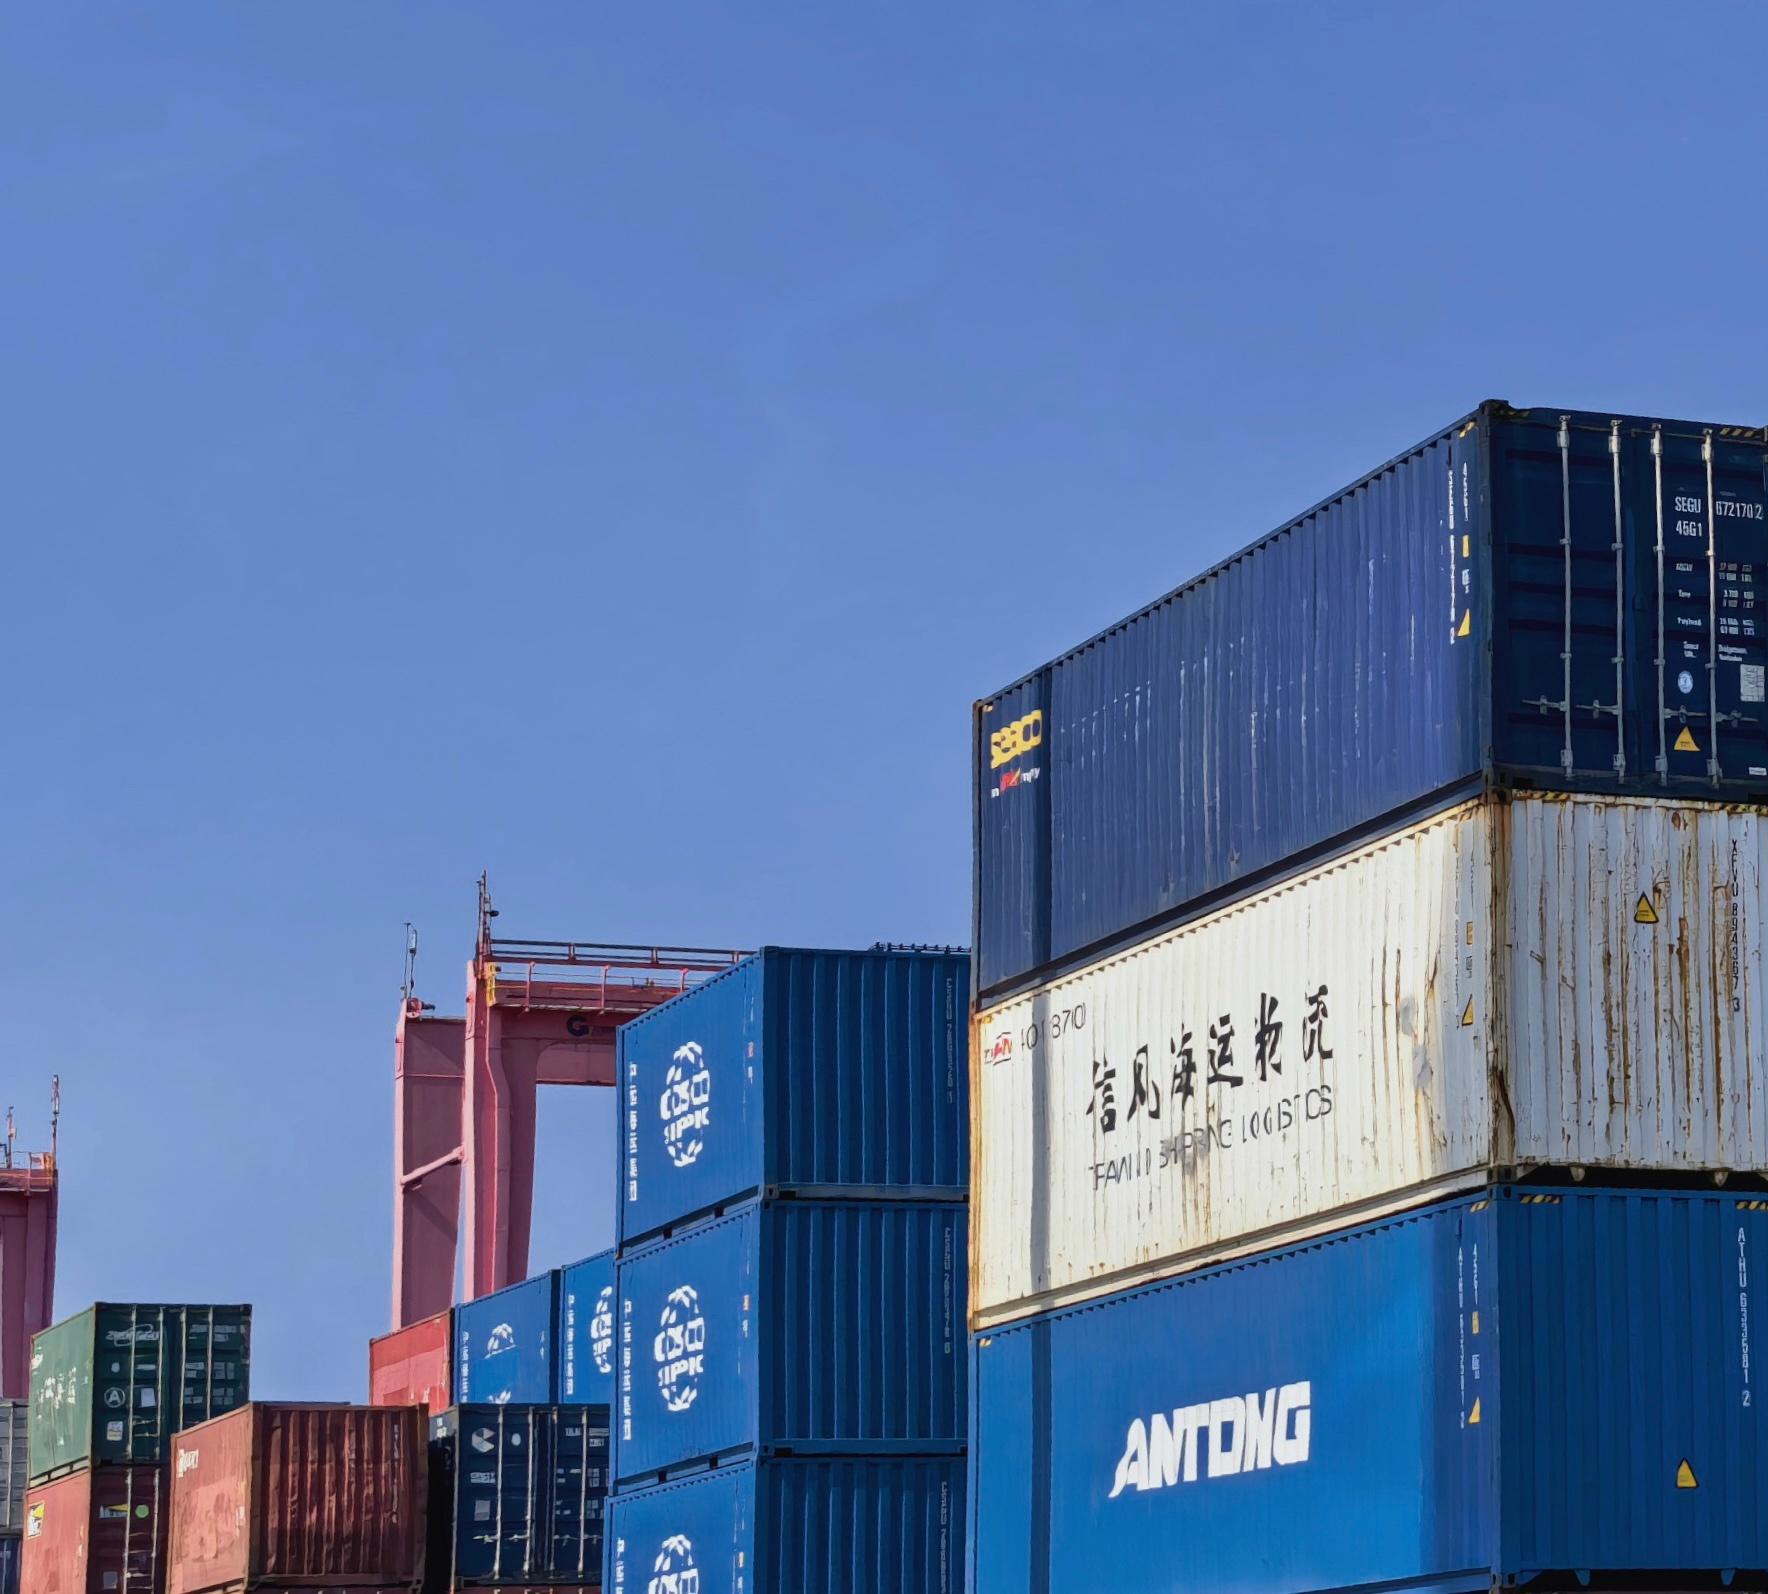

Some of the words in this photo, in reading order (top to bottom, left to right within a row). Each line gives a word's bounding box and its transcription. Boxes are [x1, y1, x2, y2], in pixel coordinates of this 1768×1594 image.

[1674, 496, 1702, 514] SEGU
[1675, 520, 1703, 537] 45G1
[1731, 839, 1739, 897] XFVU
[1737, 1227, 1748, 1288] ATHU
[1107, 1380, 1312, 1499] ANTONG
